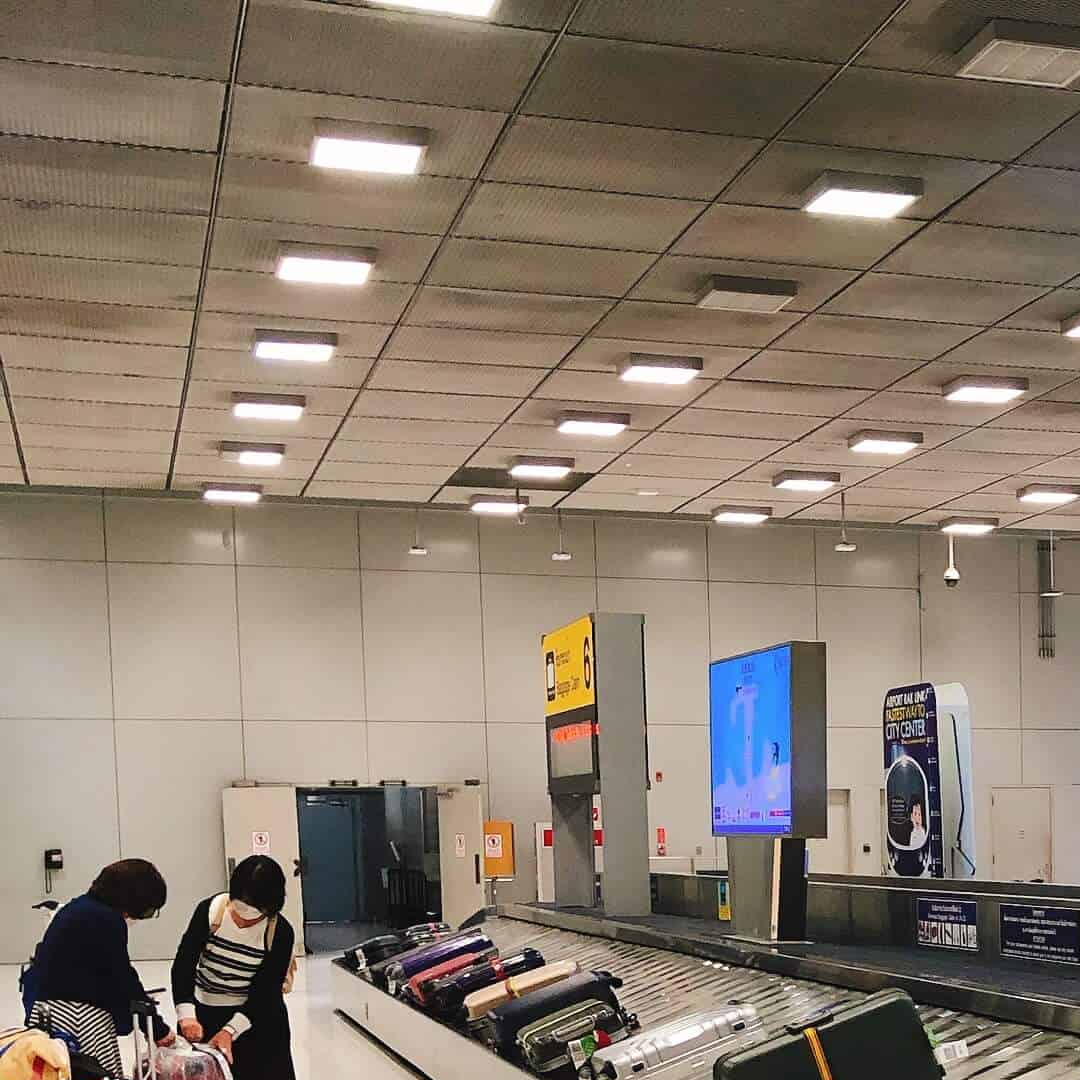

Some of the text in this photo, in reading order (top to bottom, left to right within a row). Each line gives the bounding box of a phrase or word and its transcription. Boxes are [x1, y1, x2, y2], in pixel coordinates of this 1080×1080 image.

[583, 636, 591, 690] 6
[886, 719, 926, 740] CITY CENTER
